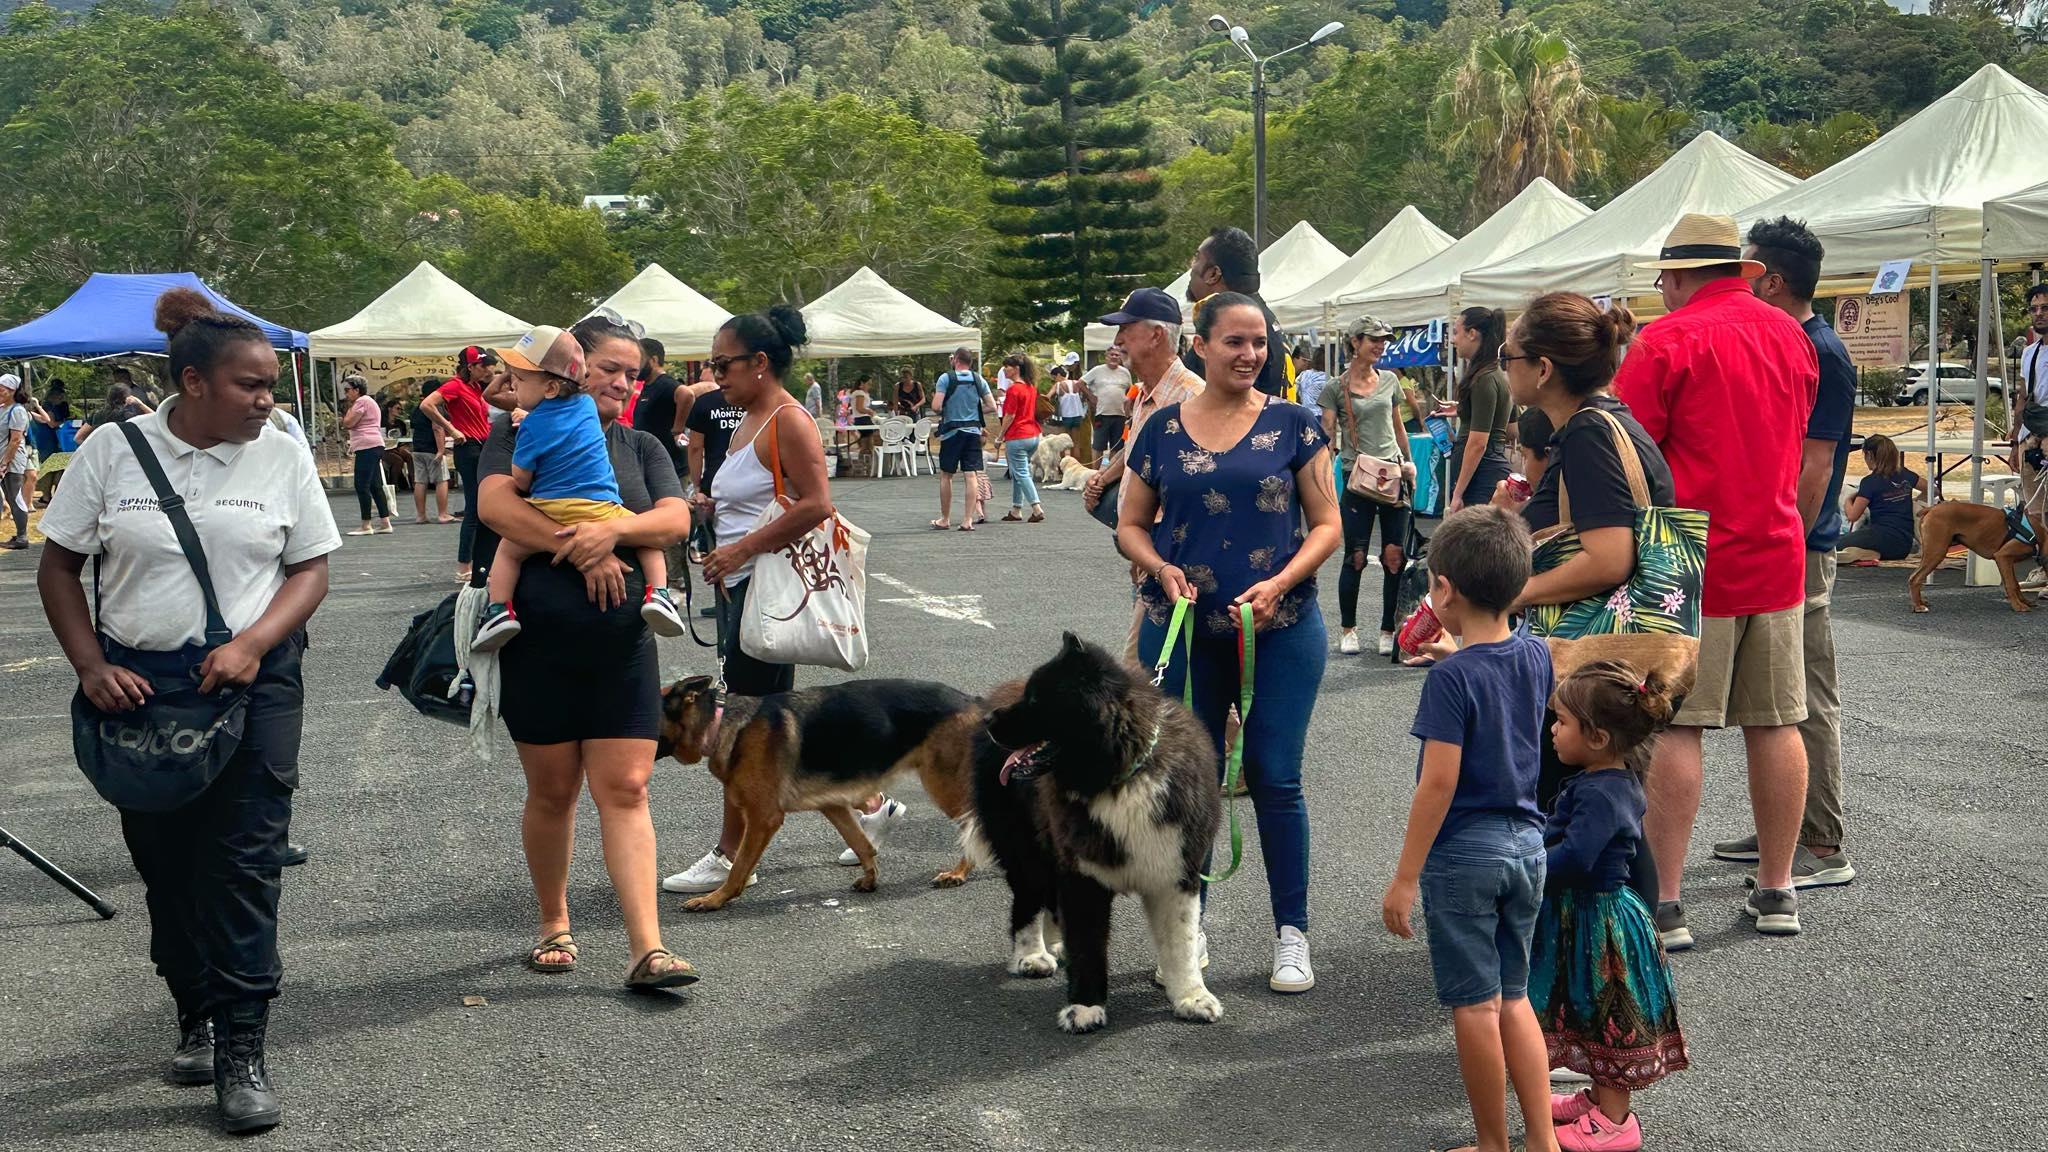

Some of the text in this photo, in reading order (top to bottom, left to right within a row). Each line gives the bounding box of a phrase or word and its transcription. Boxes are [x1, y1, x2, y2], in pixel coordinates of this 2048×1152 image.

[370, 358, 391, 371] La
[711, 409, 744, 419] MONT-D
[119, 498, 160, 507] SPHIN
[214, 500, 265, 512] SECURITE
[117, 505, 162, 513] PROTECTIO
